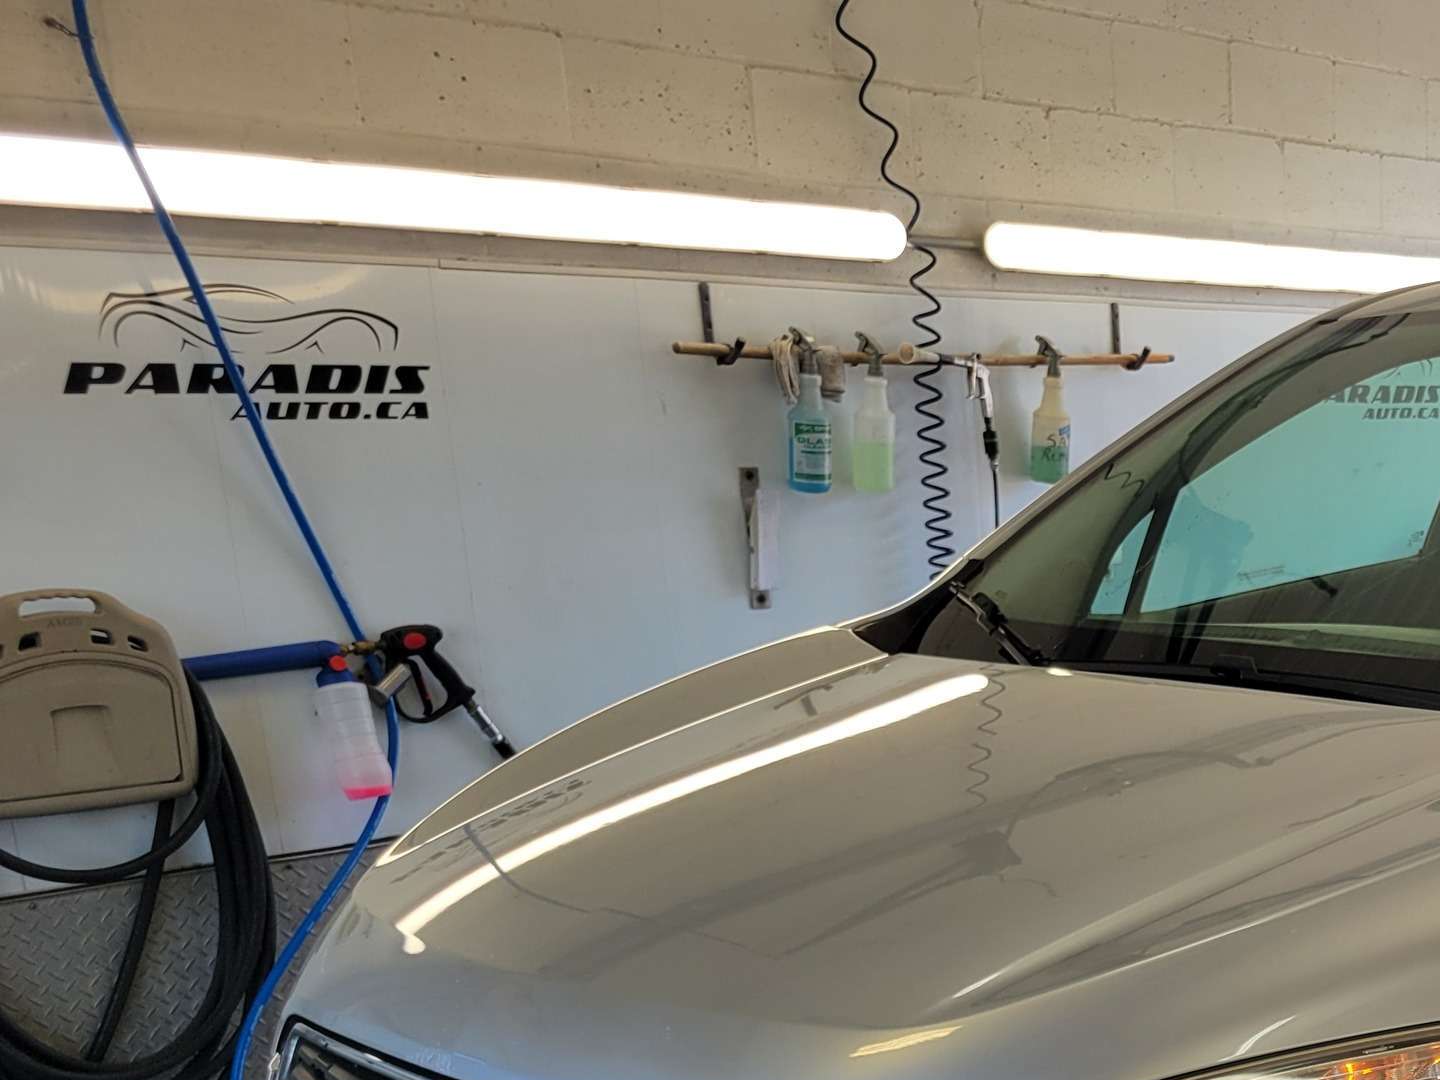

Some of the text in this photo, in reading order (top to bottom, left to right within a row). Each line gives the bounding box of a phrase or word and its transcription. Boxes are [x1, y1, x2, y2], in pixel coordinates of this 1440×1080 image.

[63, 362, 431, 395] PARADIS
[230, 401, 430, 421] AUTO.CA
[1361, 407, 1440, 420] AUTO.CA
